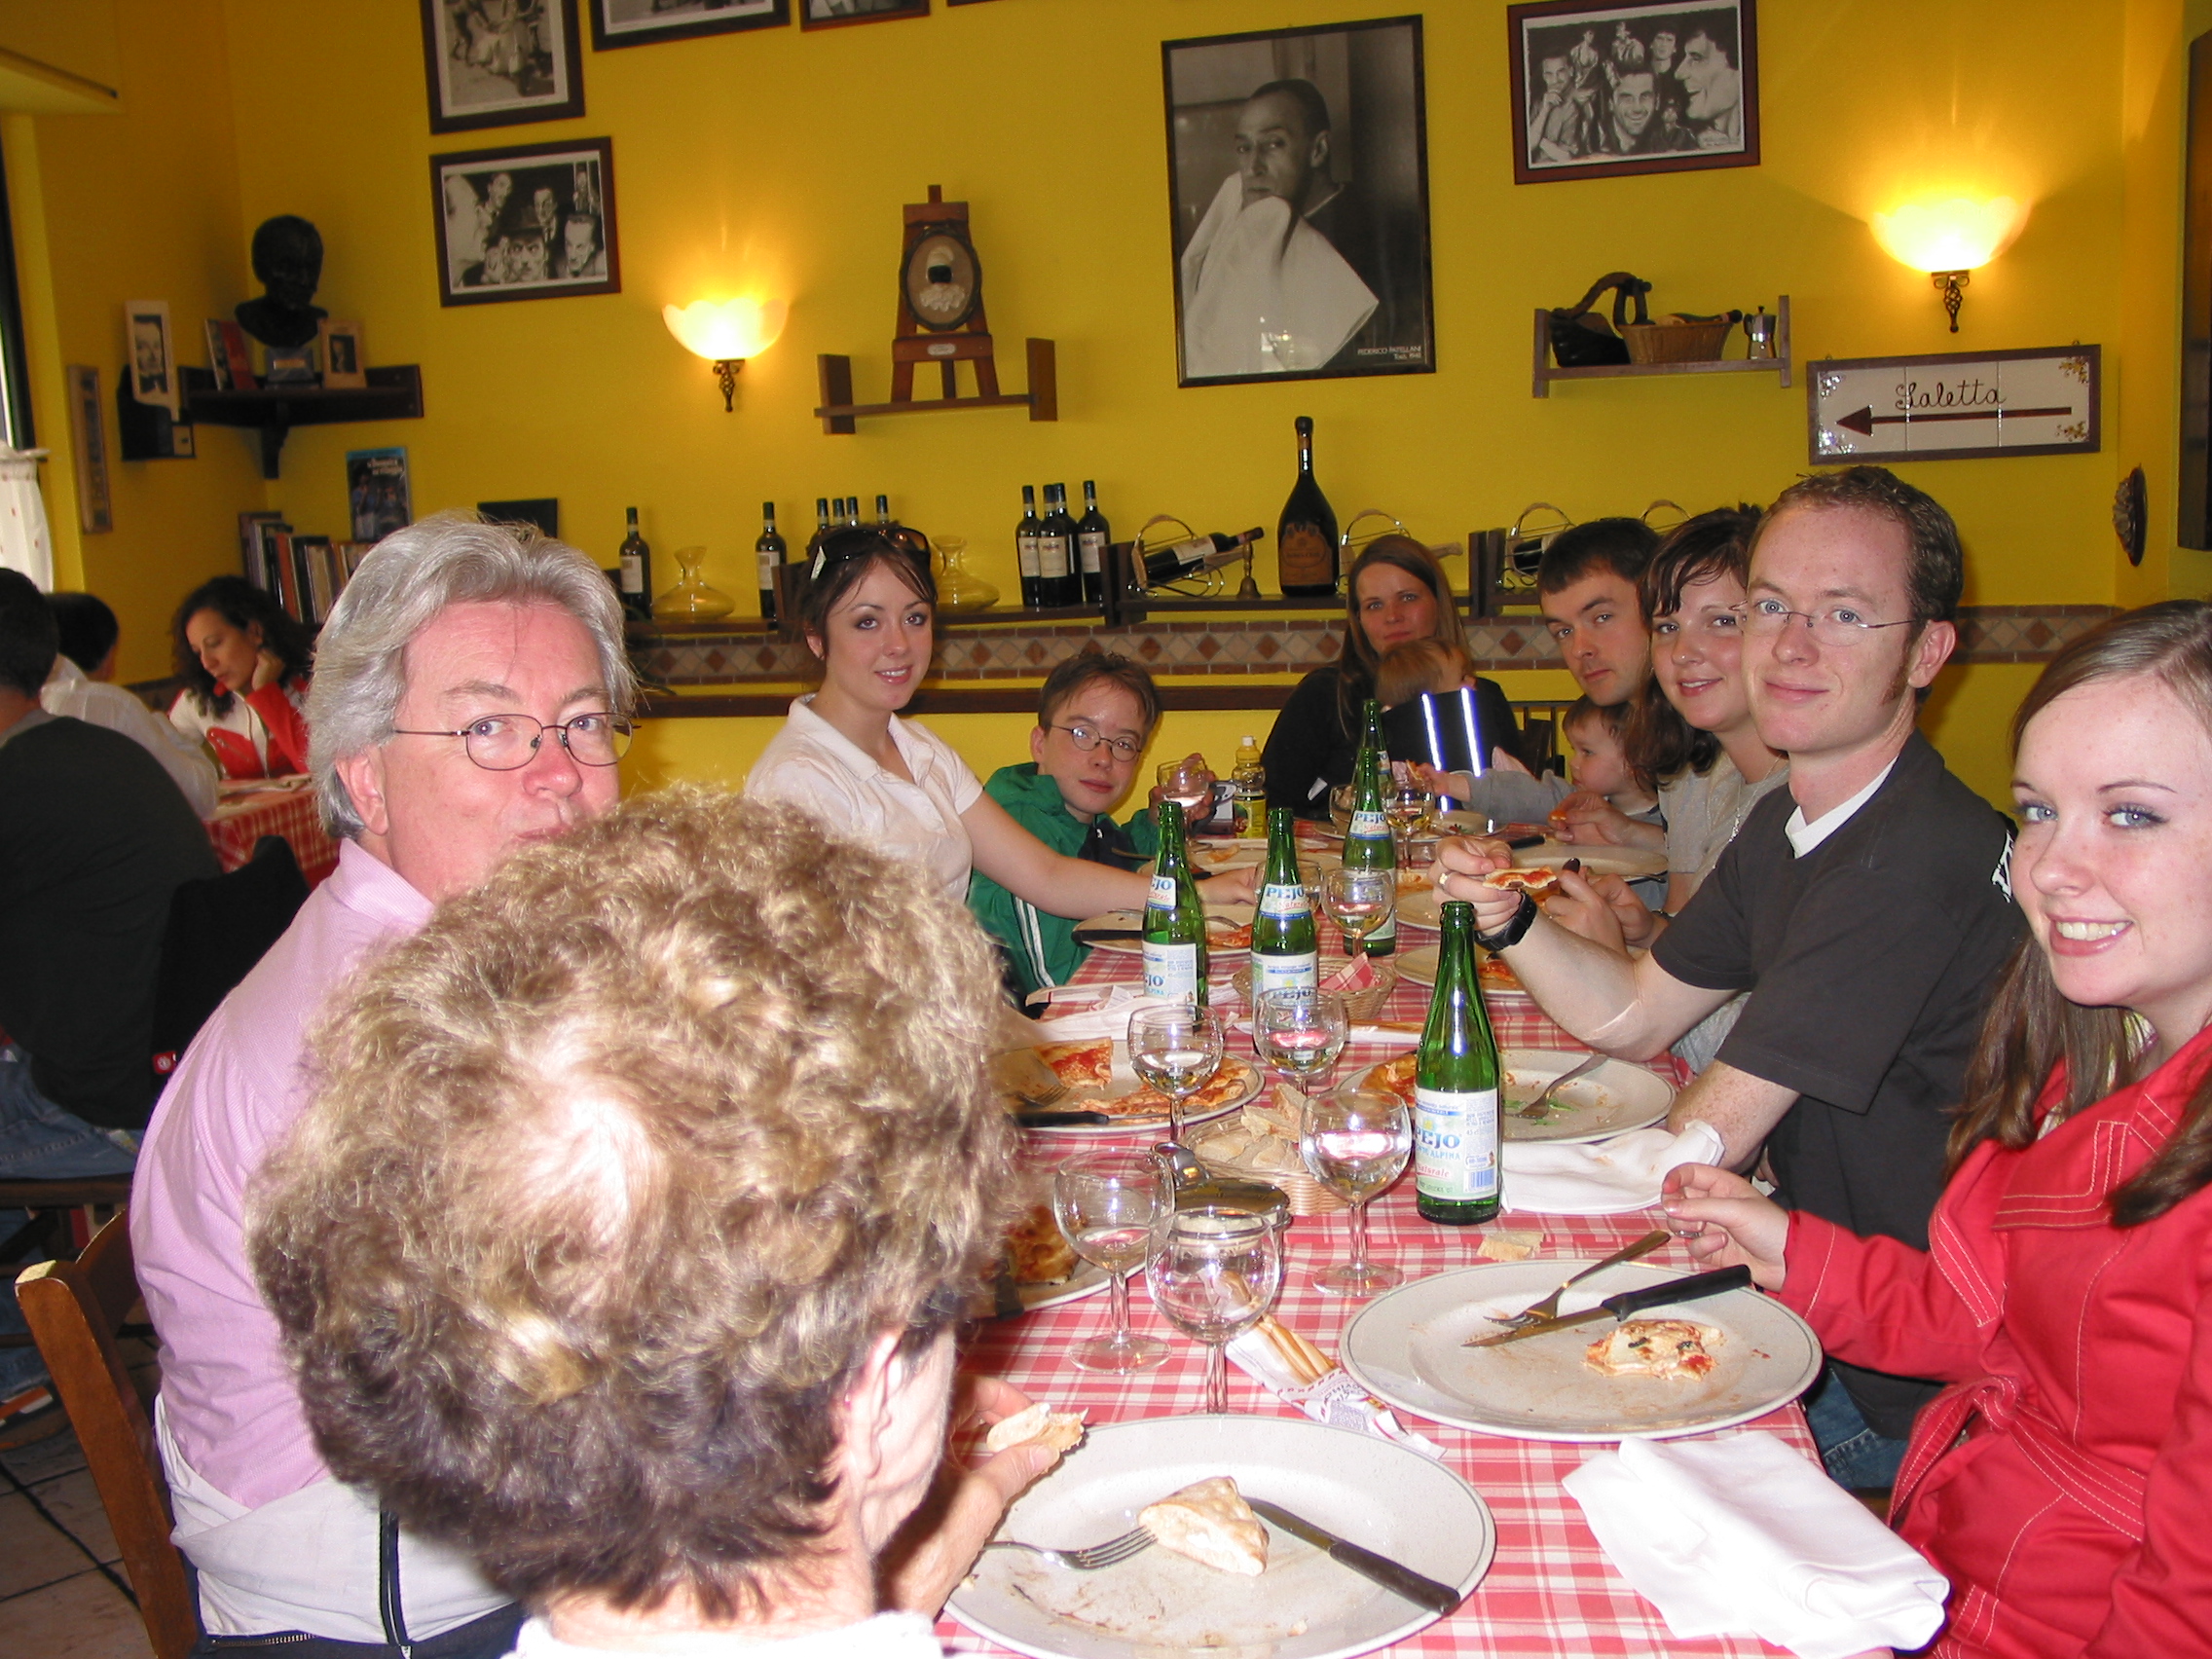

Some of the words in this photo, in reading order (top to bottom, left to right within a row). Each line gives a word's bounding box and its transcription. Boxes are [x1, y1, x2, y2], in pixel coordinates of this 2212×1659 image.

[1895, 378, 2007, 411] Saletta
[1354, 812, 1386, 825] PEJO
[1266, 886, 1305, 901] PEJO
